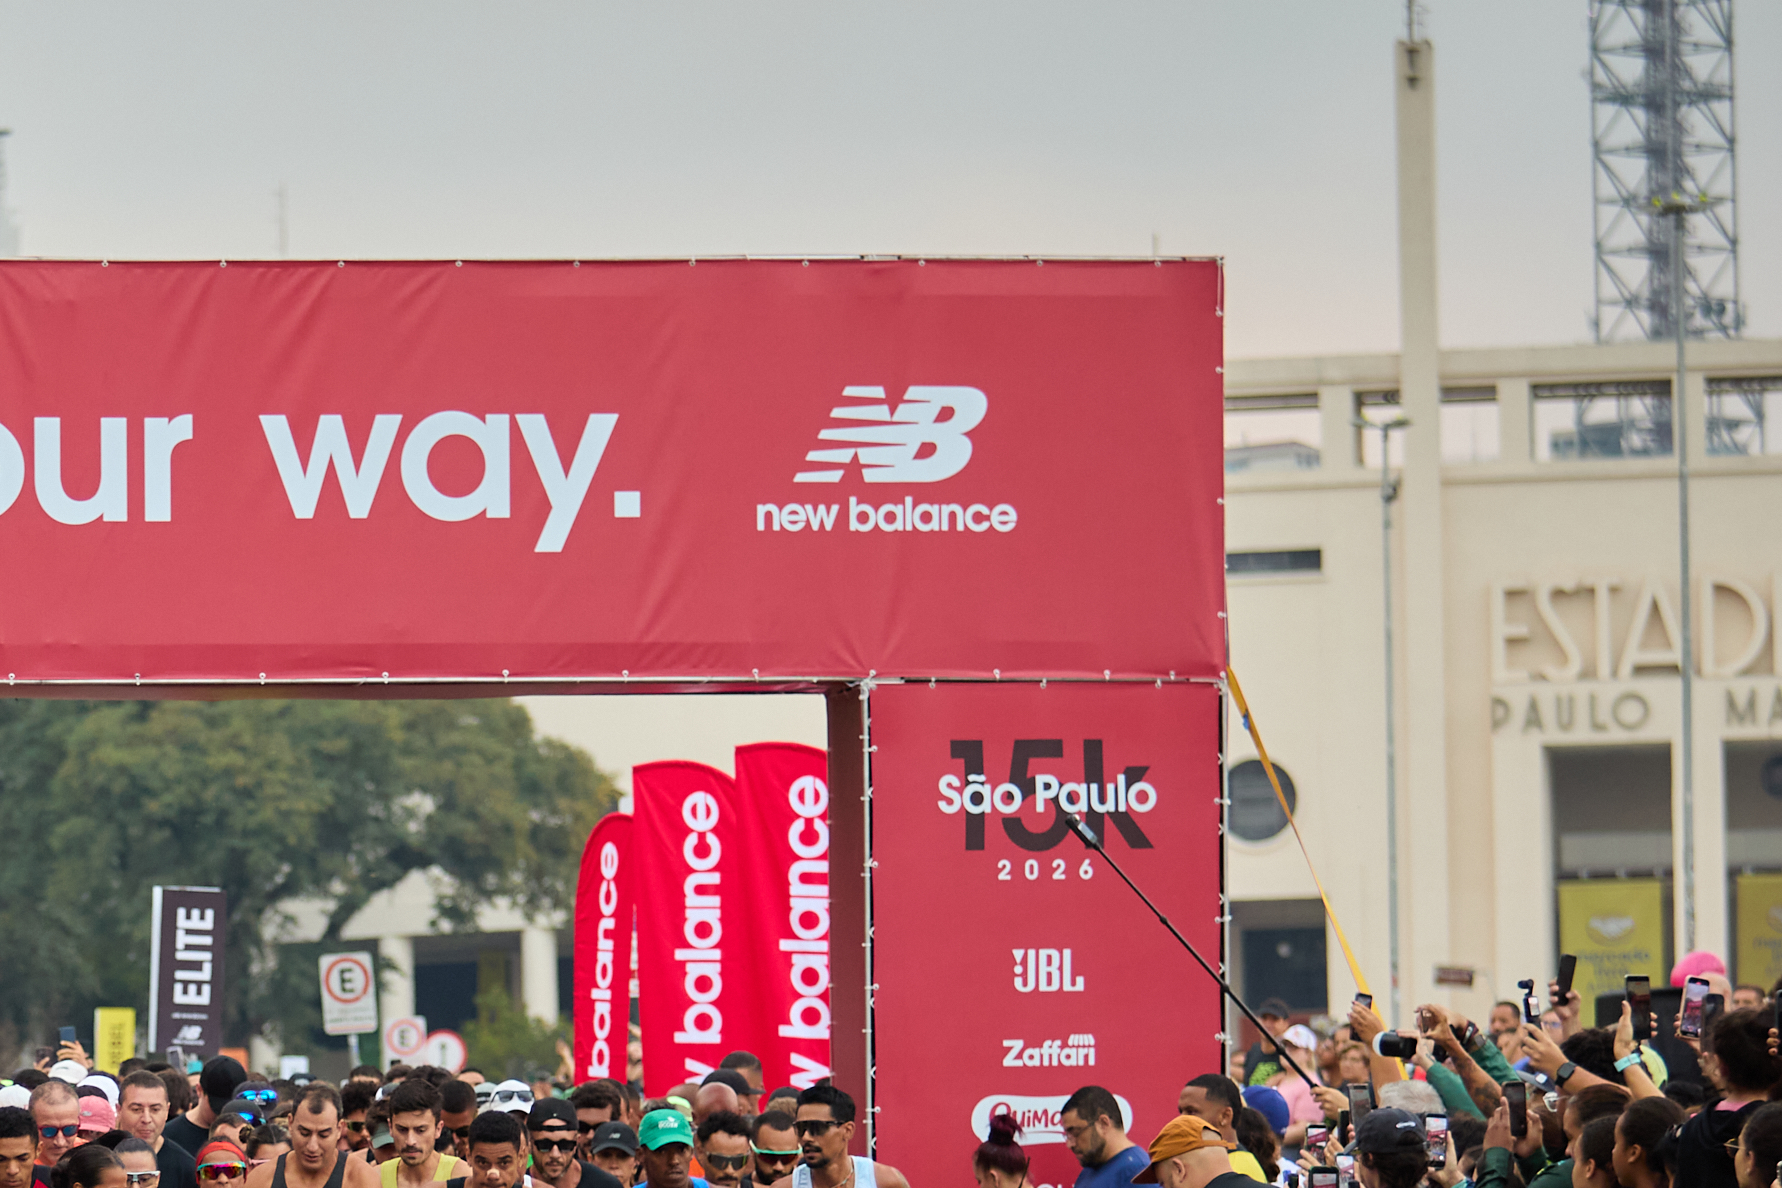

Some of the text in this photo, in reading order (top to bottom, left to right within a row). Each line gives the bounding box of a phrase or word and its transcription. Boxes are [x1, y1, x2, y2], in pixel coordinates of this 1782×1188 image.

[259, 410, 642, 553] way.
[757, 496, 1018, 533] new balance
[1492, 690, 1651, 732] PAULO
[937, 773, 1158, 815] São Paulo
[950, 738, 1155, 852] 15k
[997, 859, 1094, 881] 2026
[673, 791, 723, 1044] balance
[778, 775, 830, 1040] balance
[173, 907, 215, 1006] ELITE
[588, 841, 619, 1078] balance
[1013, 949, 1084, 992] JBL
[339, 967, 356, 994] E
[1003, 1034, 1095, 1066] Zaffari
